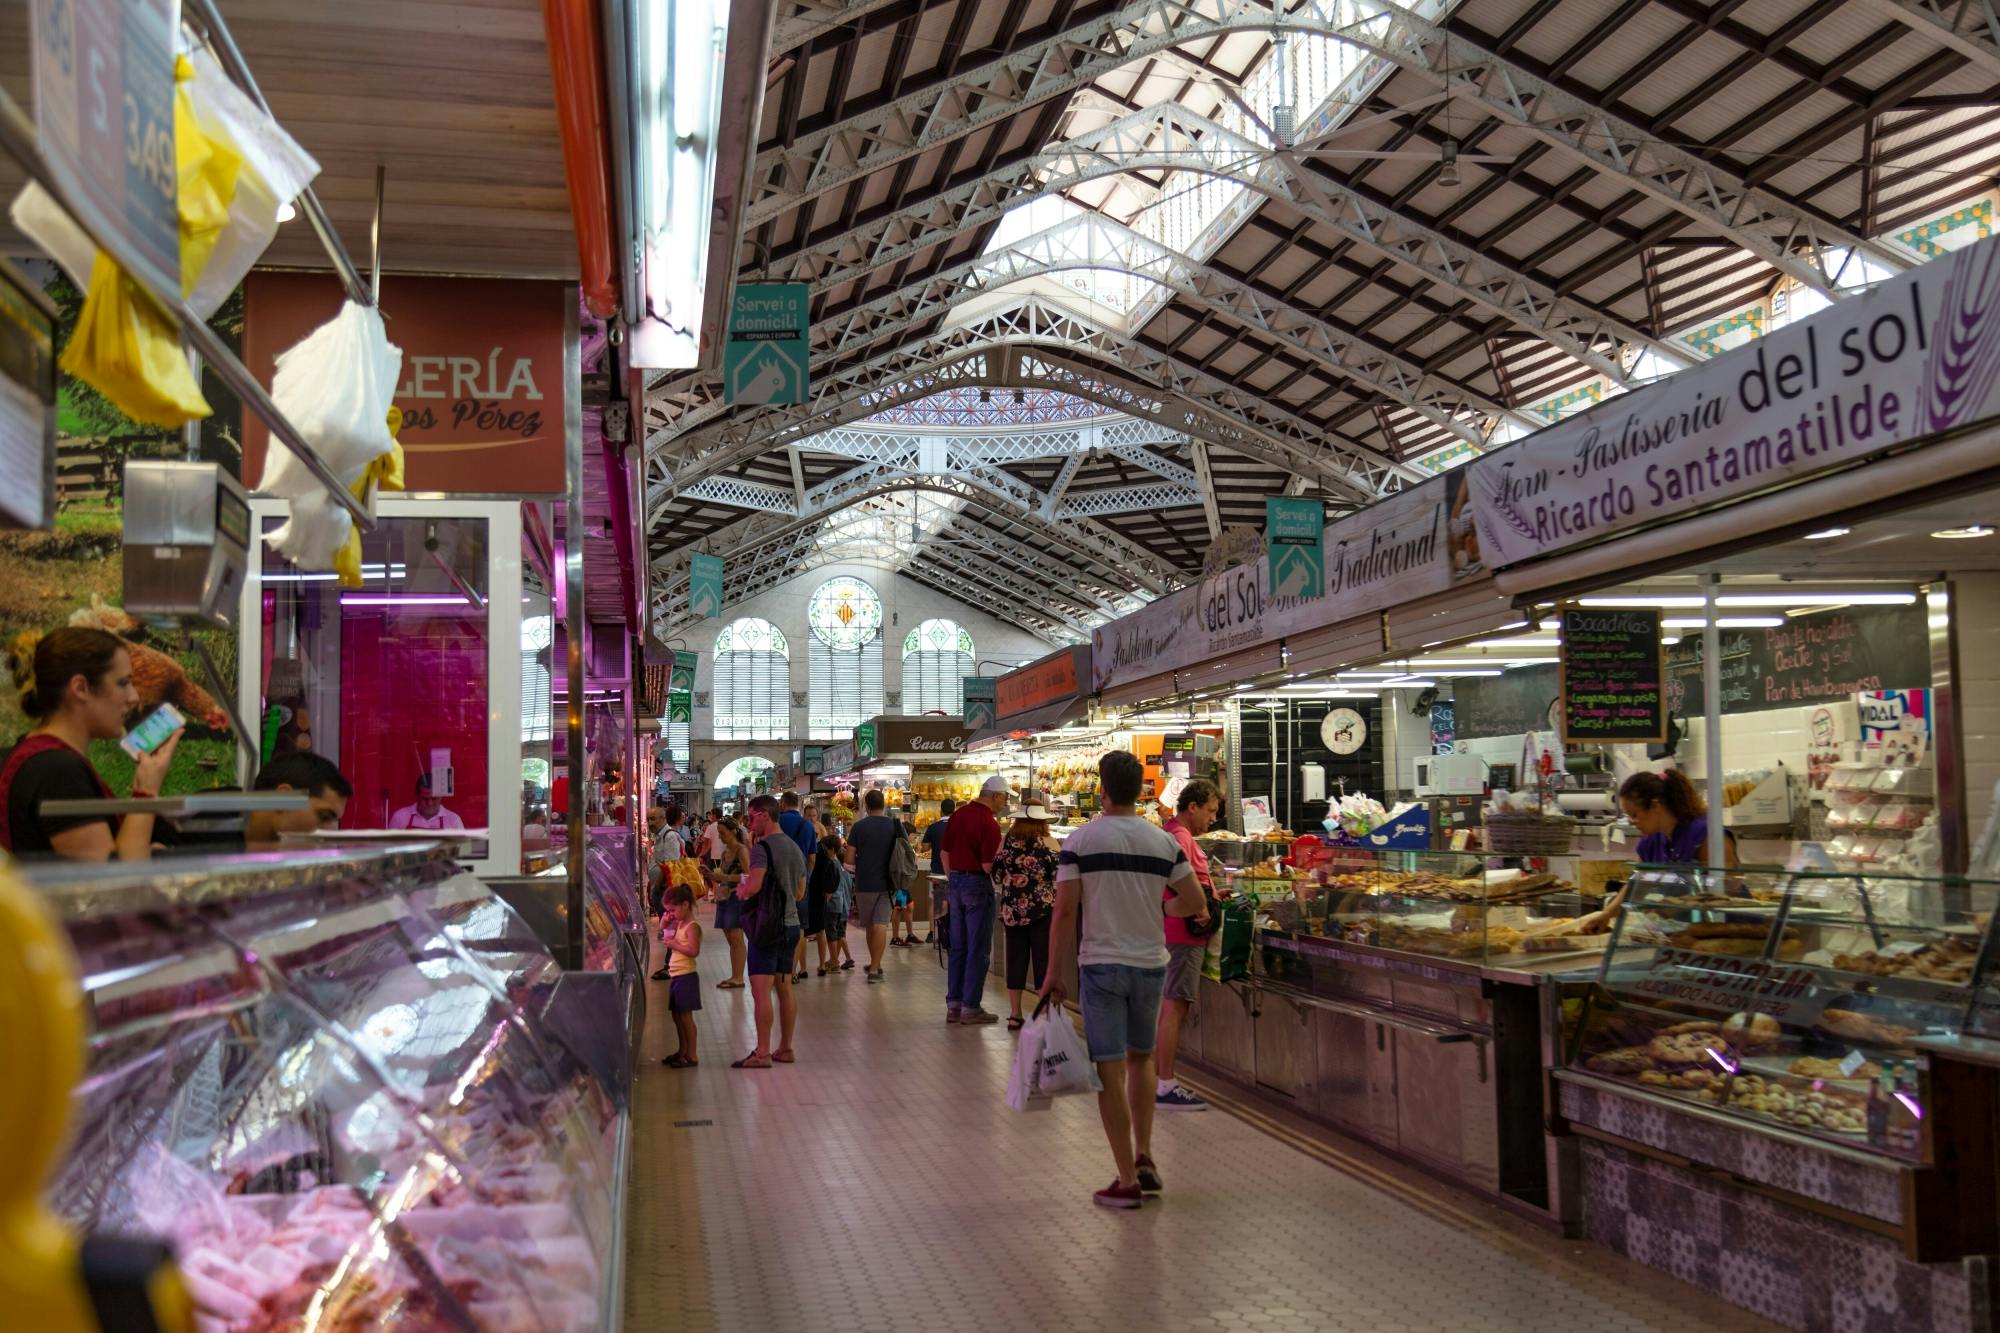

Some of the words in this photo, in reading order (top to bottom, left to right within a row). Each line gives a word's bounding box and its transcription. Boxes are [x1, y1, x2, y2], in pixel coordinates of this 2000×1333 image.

[736, 296, 783, 312] Servei
[788, 298, 797, 311] a
[736, 313, 797, 330] domicili
[1739, 326, 1817, 413] del
[1841, 281, 1927, 376] sol
[452, 399, 544, 437] Pérez
[1494, 461, 1548, 505] Forn
[1574, 393, 1729, 478] Pastisseria
[1535, 478, 1634, 541] Ricardo
[1646, 384, 1899, 506] Santamatilde
[1275, 507, 1307, 521] Servei
[1276, 523, 1316, 536] domicili
[1332, 503, 1440, 594] Tradicional
[1208, 577, 1231, 632] del
[1238, 565, 1264, 622] Sol
[1567, 611, 1650, 633] Bocadillos
[1765, 628, 1789, 650] Pan
[1821, 652, 1829, 672] y
[1765, 675, 1789, 701] Pan
[1860, 705, 1898, 721] VIDAL
[910, 736, 944, 750] Casa
